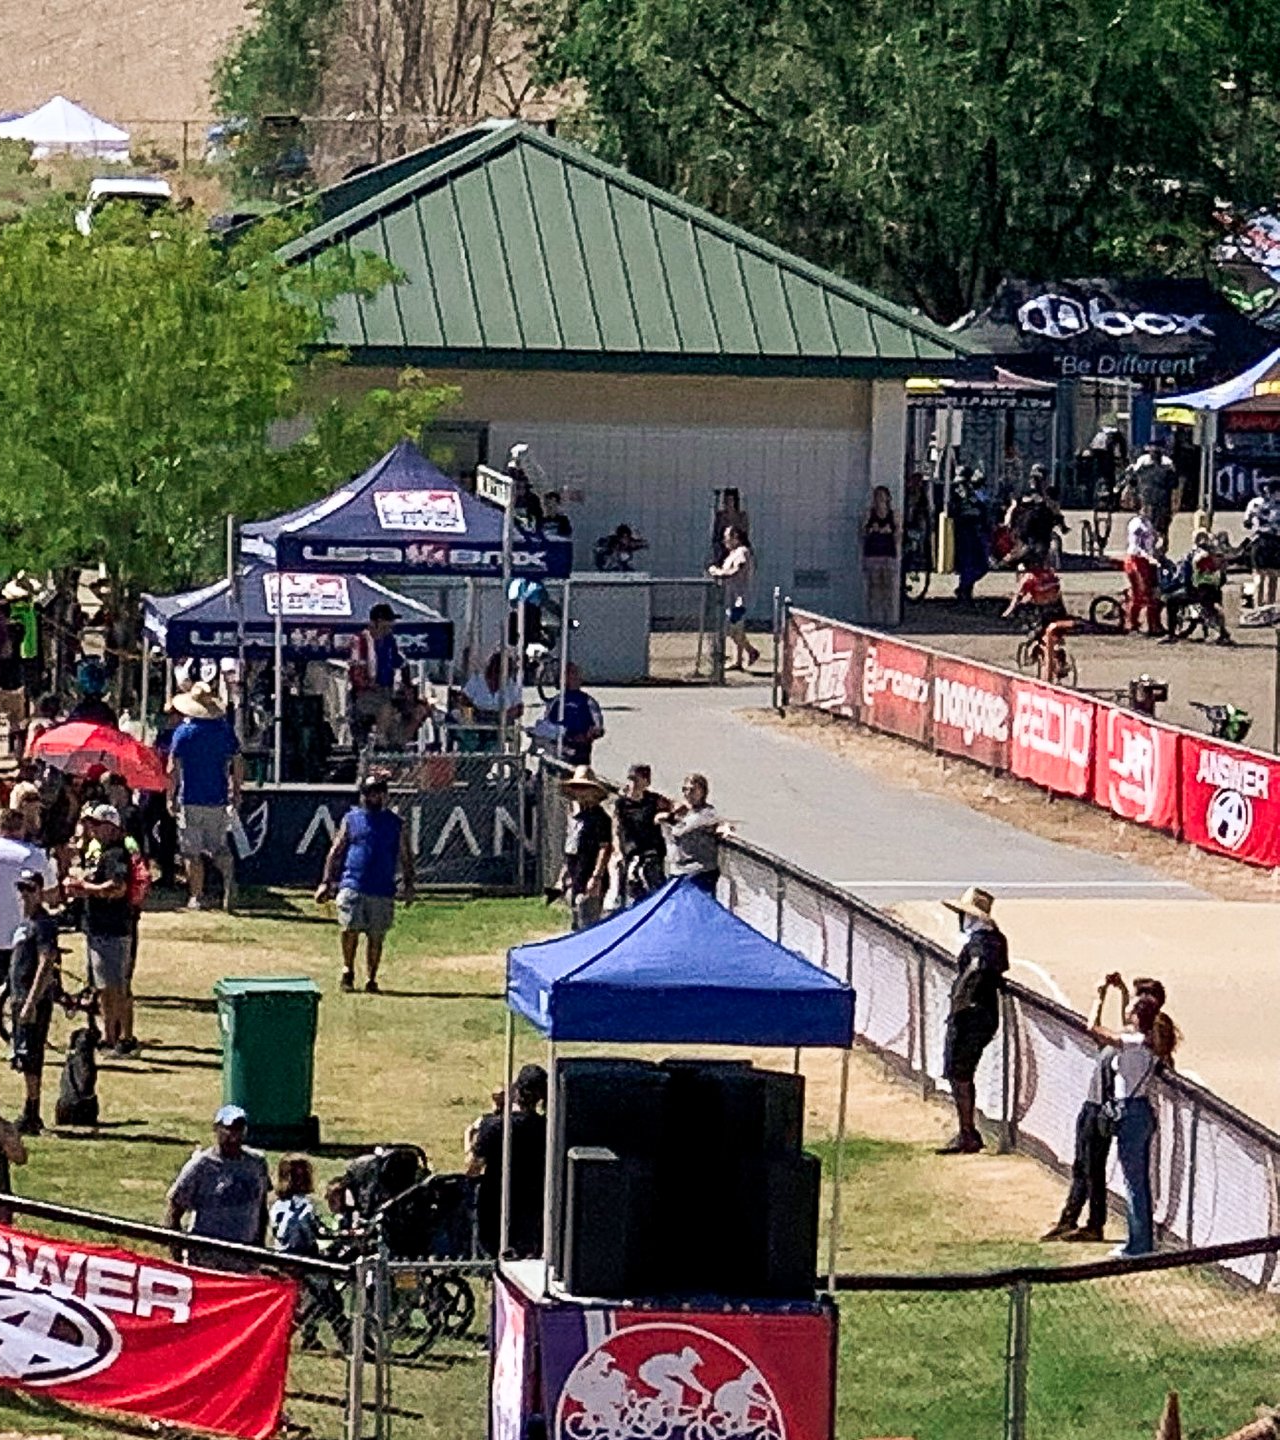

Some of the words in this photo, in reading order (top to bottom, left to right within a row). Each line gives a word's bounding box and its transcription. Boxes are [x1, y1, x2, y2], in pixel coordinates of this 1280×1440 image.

[1089, 297, 1216, 336] box
[1195, 748, 1270, 801] ANSWER
[296, 803, 538, 857] AIAN
